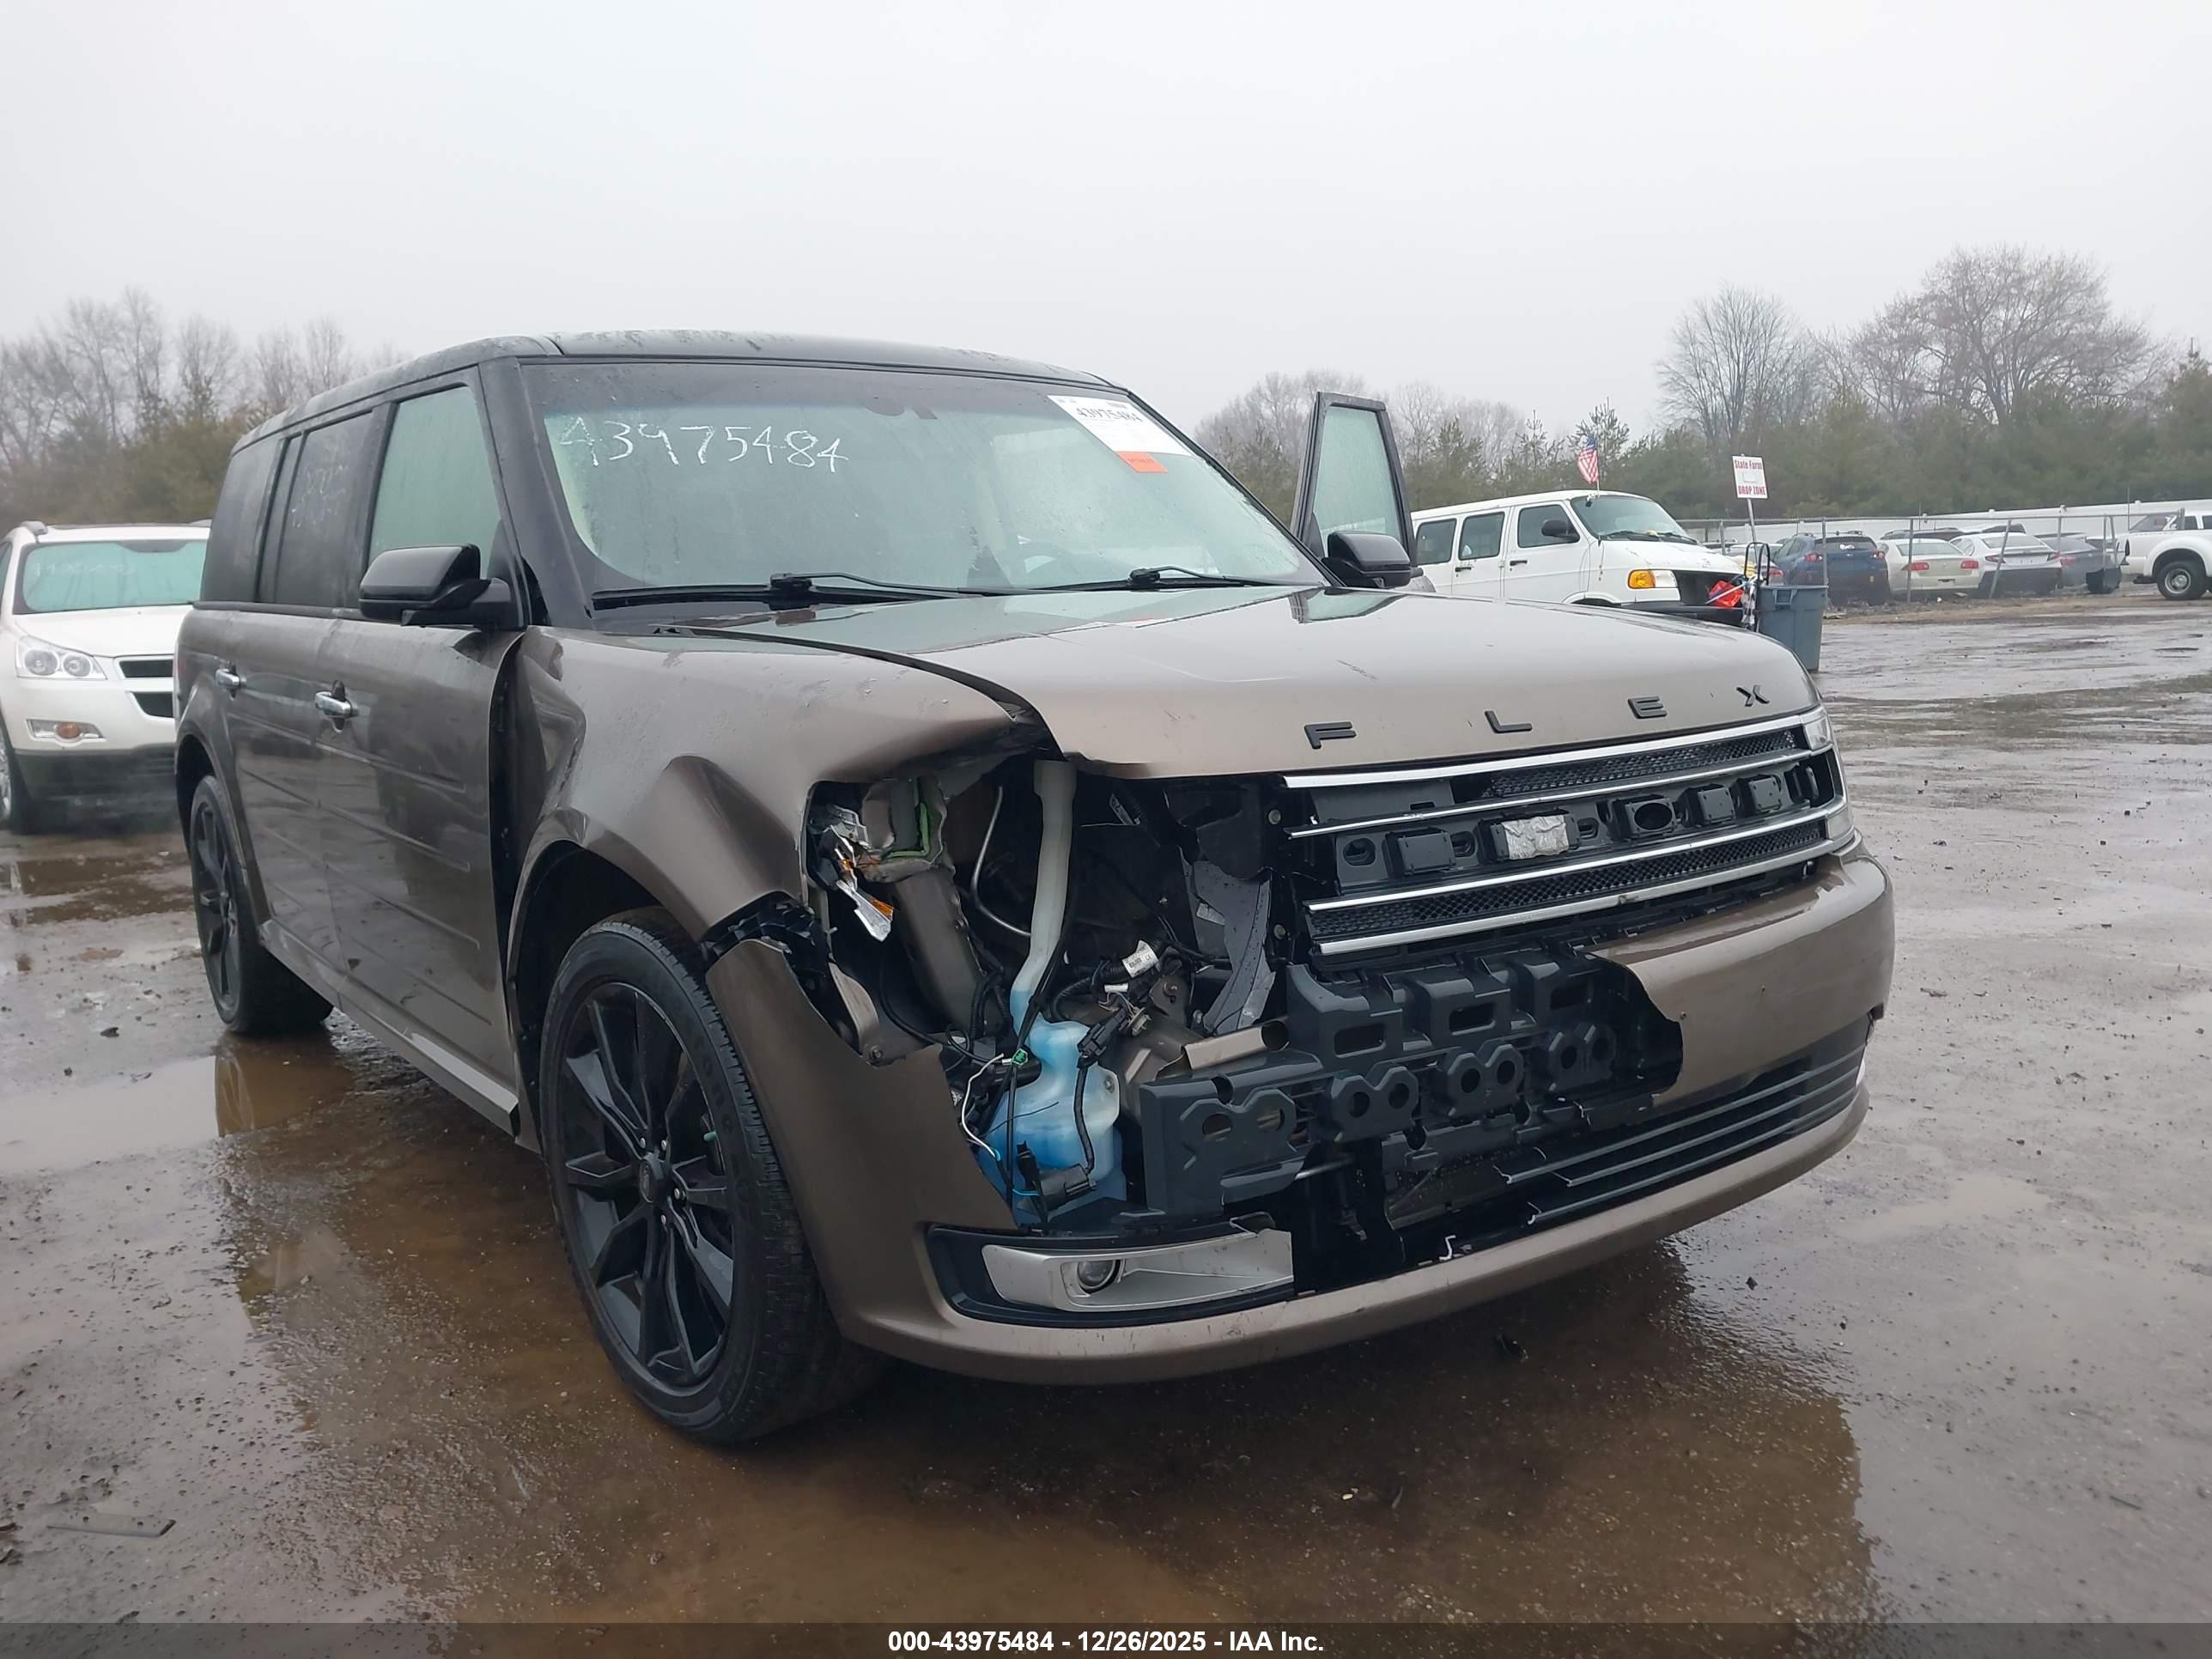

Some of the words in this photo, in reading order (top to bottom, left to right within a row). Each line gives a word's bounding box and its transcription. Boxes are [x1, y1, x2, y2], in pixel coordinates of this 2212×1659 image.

[560, 416, 849, 473] 43975484
[1735, 460, 1748, 470] State
[1749, 460, 1762, 470] Farm
[1739, 486, 1752, 495] DROP
[1753, 486, 1765, 495] ZONE
[1304, 684, 1770, 750] FLEX
